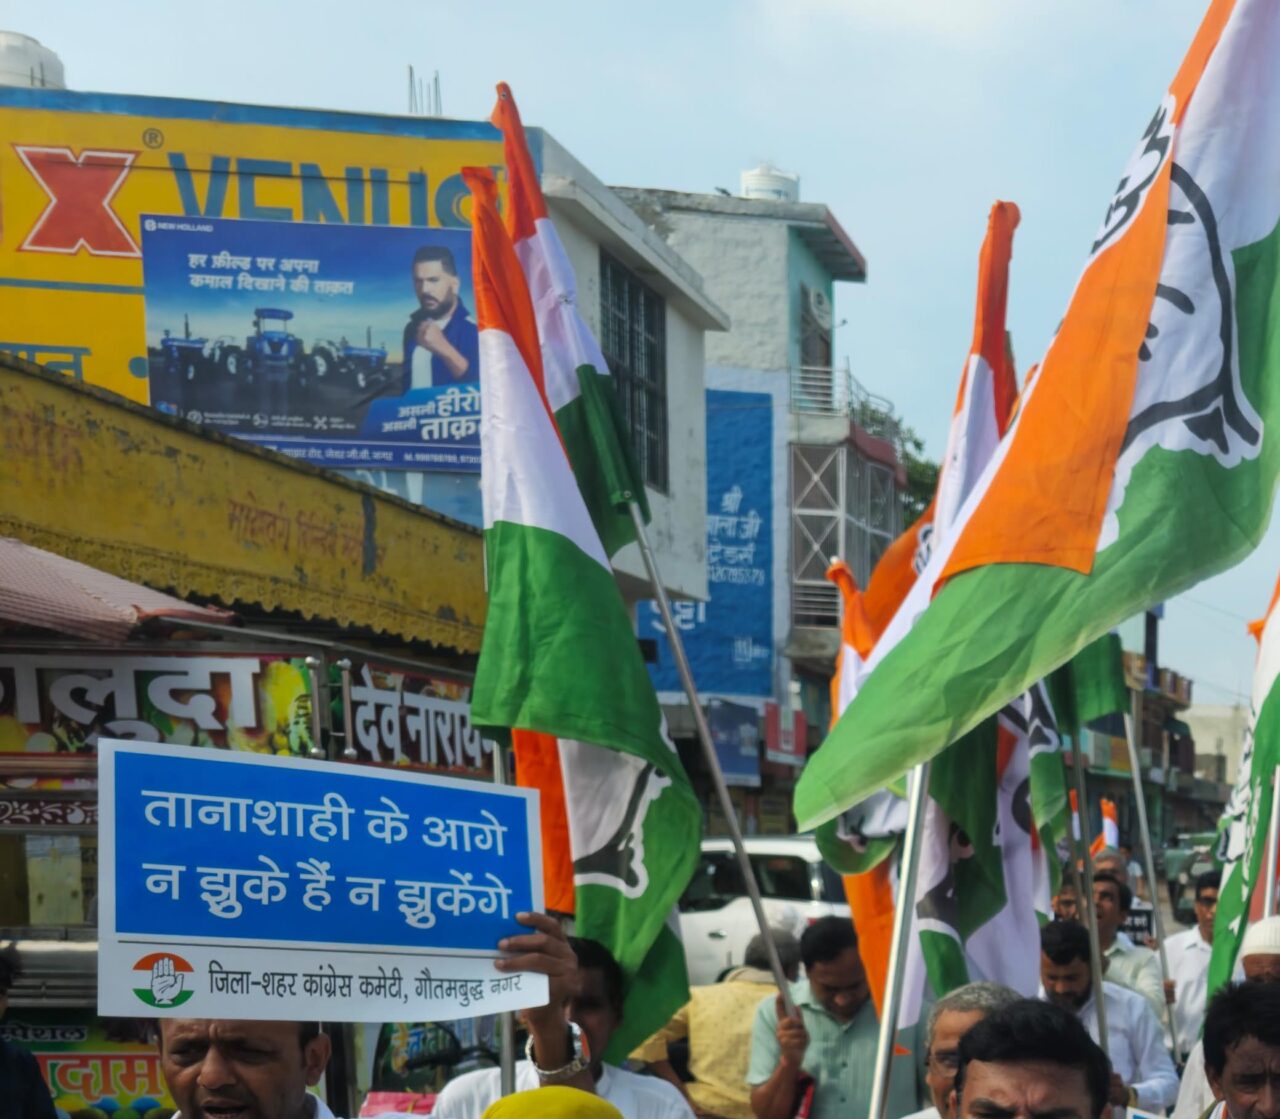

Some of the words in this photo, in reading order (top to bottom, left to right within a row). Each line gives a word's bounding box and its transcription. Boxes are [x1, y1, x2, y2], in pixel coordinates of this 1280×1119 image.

[189, 273, 234, 290] कमाल
[237, 272, 285, 292] दिखाने
[290, 275, 310, 293] की
[256, 256, 275, 271] पर
[279, 257, 320, 273] अपना
[141, 790, 355, 842] तानाशाही
[365, 797, 409, 844] के
[423, 810, 507, 855] आगे
[142, 863, 186, 899] न
[197, 855, 289, 918] झुके
[297, 858, 335, 911] हैं
[346, 877, 385, 911] न
[395, 869, 512, 928] झुकेंगे
[303, 964, 353, 997] कांग्रेस
[358, 966, 407, 1000] कमेटी,
[414, 967, 483, 1006] गौतमबुद्ध
[490, 974, 522, 993] नगर
